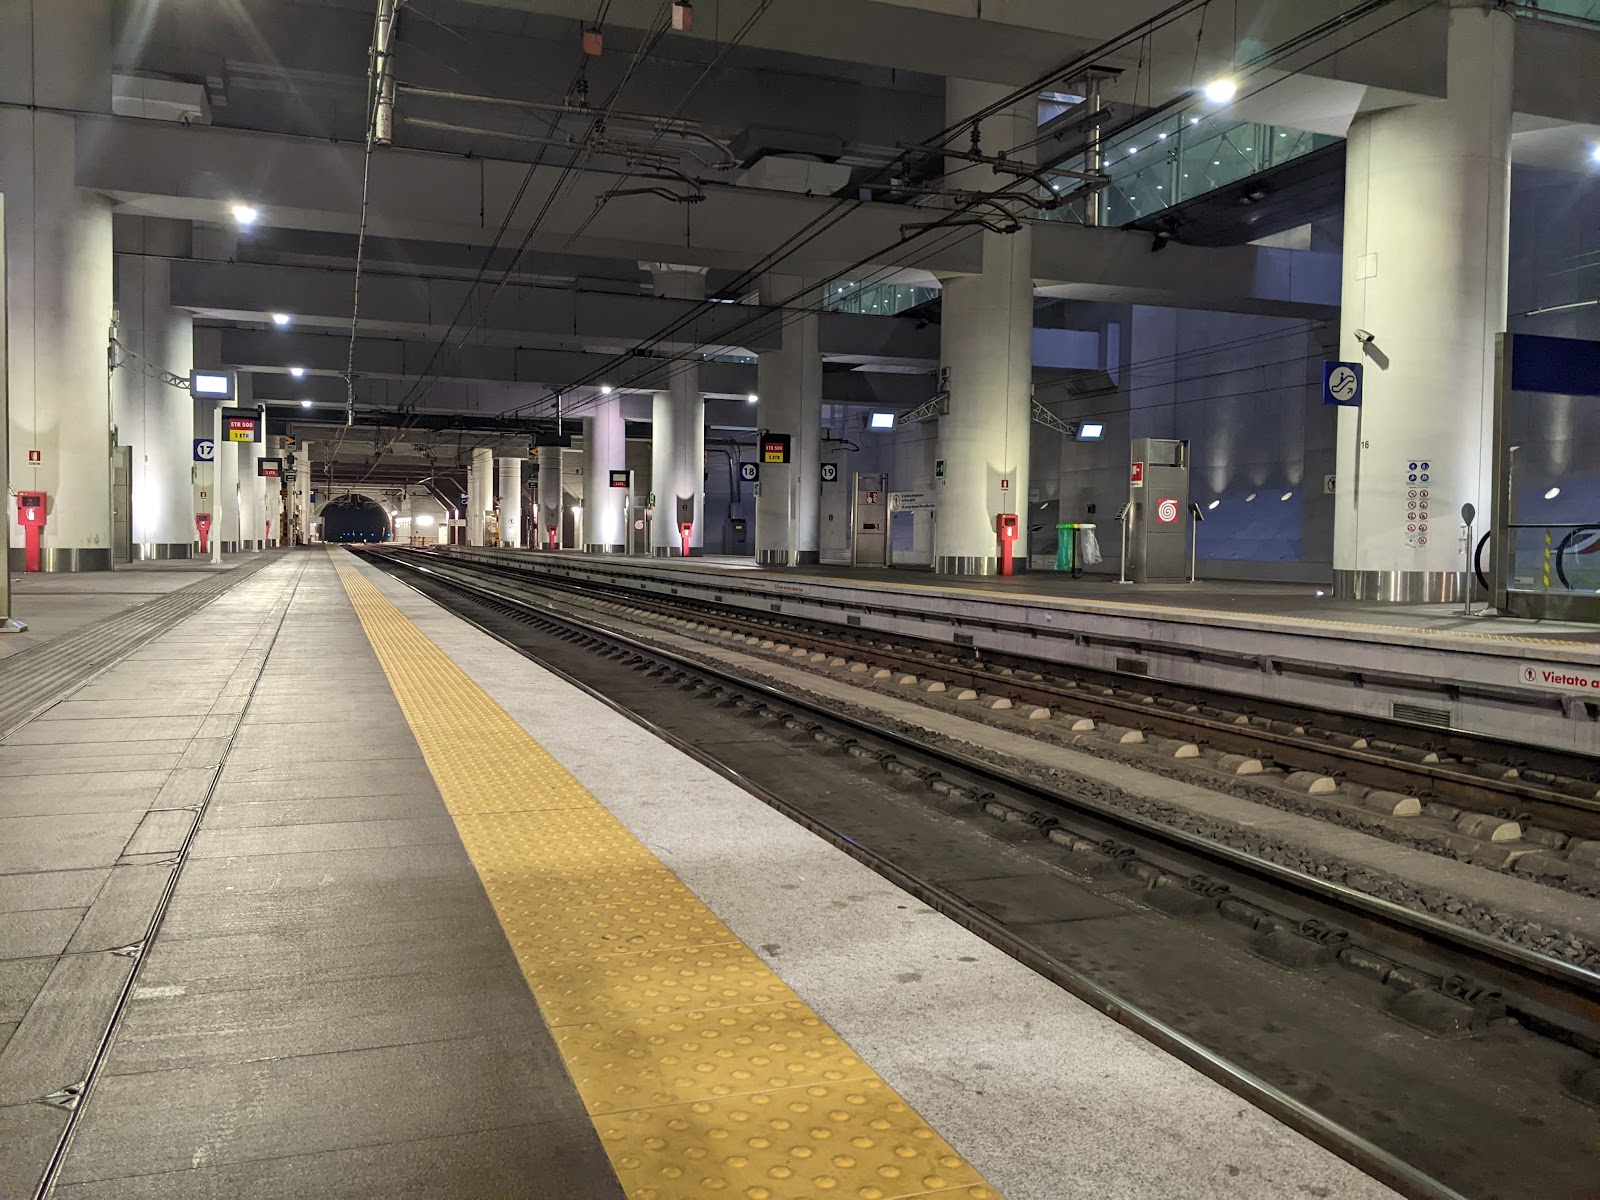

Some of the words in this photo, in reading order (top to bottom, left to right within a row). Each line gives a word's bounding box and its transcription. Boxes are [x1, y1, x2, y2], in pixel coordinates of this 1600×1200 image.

[1361, 440, 1369, 449] 16
[200, 446, 214, 454] 17
[744, 468, 754, 476] 18
[823, 468, 834, 477] 19
[1542, 671, 1587, 686] Vietato
